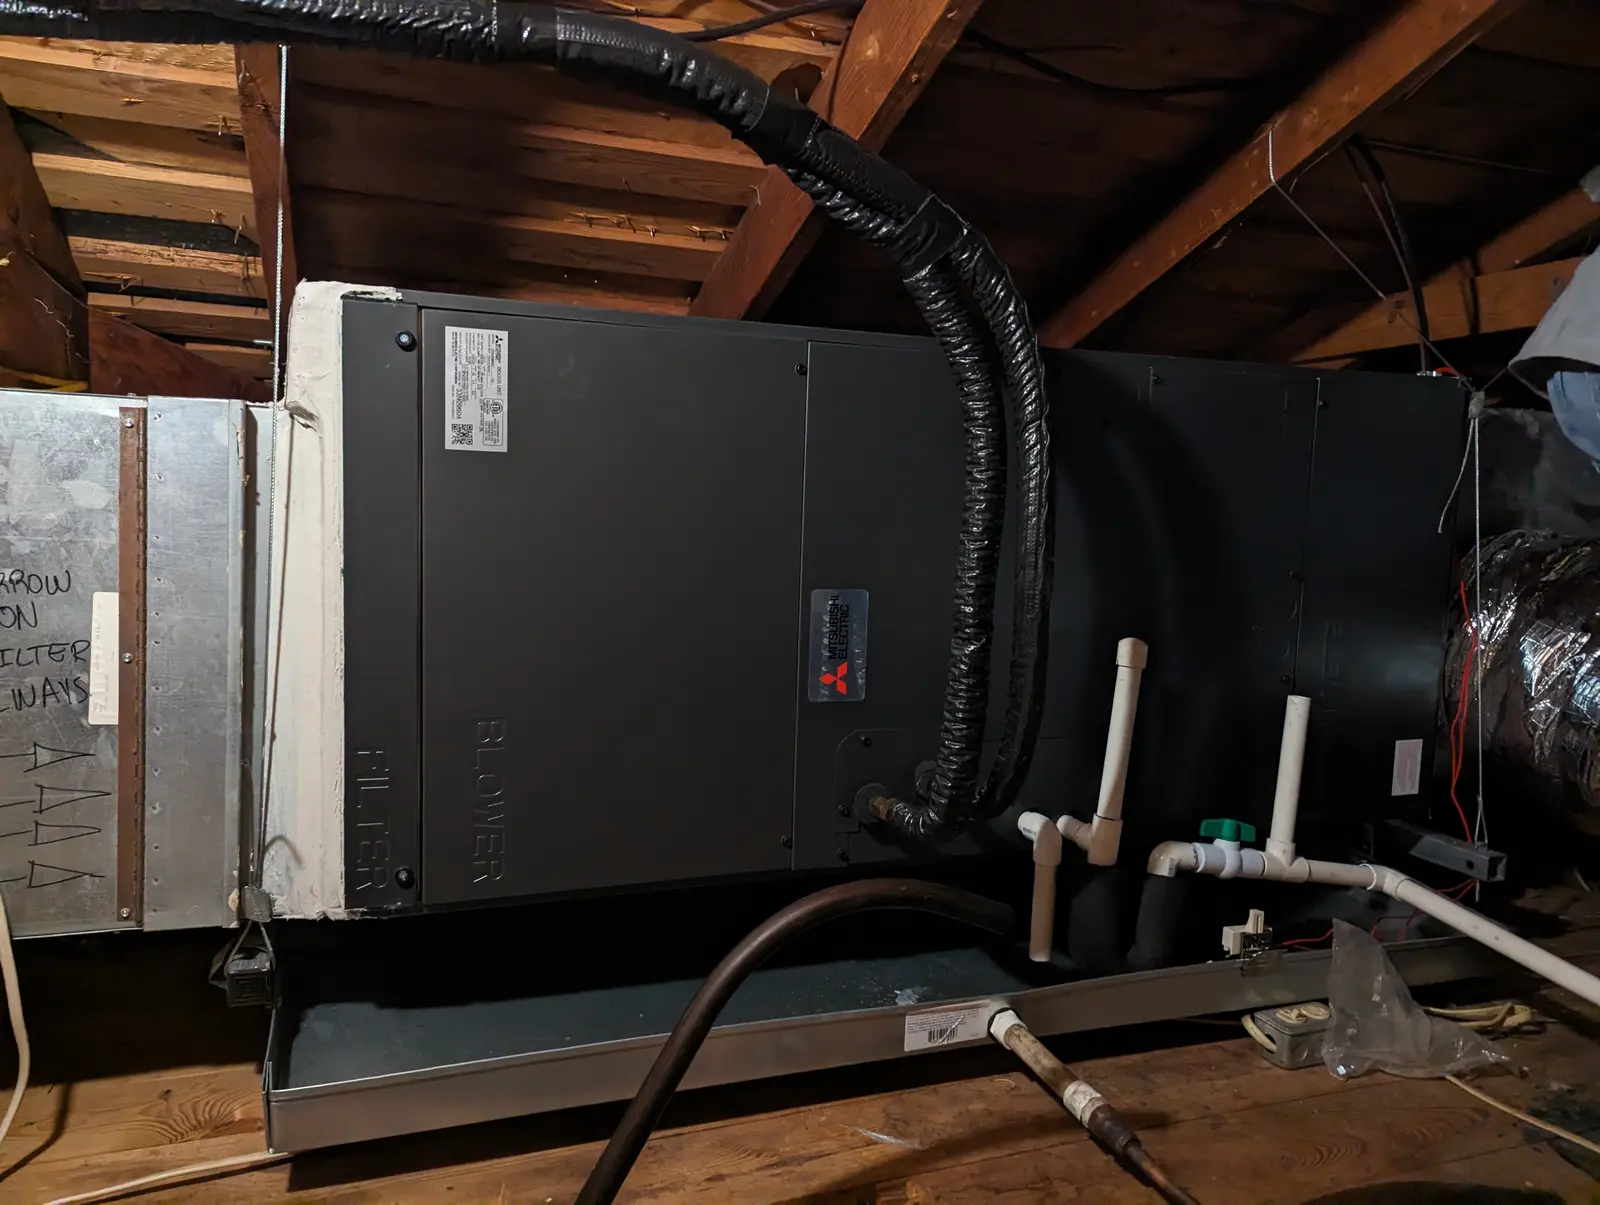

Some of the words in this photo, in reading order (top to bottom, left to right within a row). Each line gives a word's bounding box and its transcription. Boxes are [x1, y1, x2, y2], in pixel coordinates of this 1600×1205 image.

[828, 595, 840, 660] MITSUBISHI
[839, 603, 850, 660] ELECTRIC
[356, 748, 390, 890] FILTER
[472, 717, 505, 883] BLOWER
